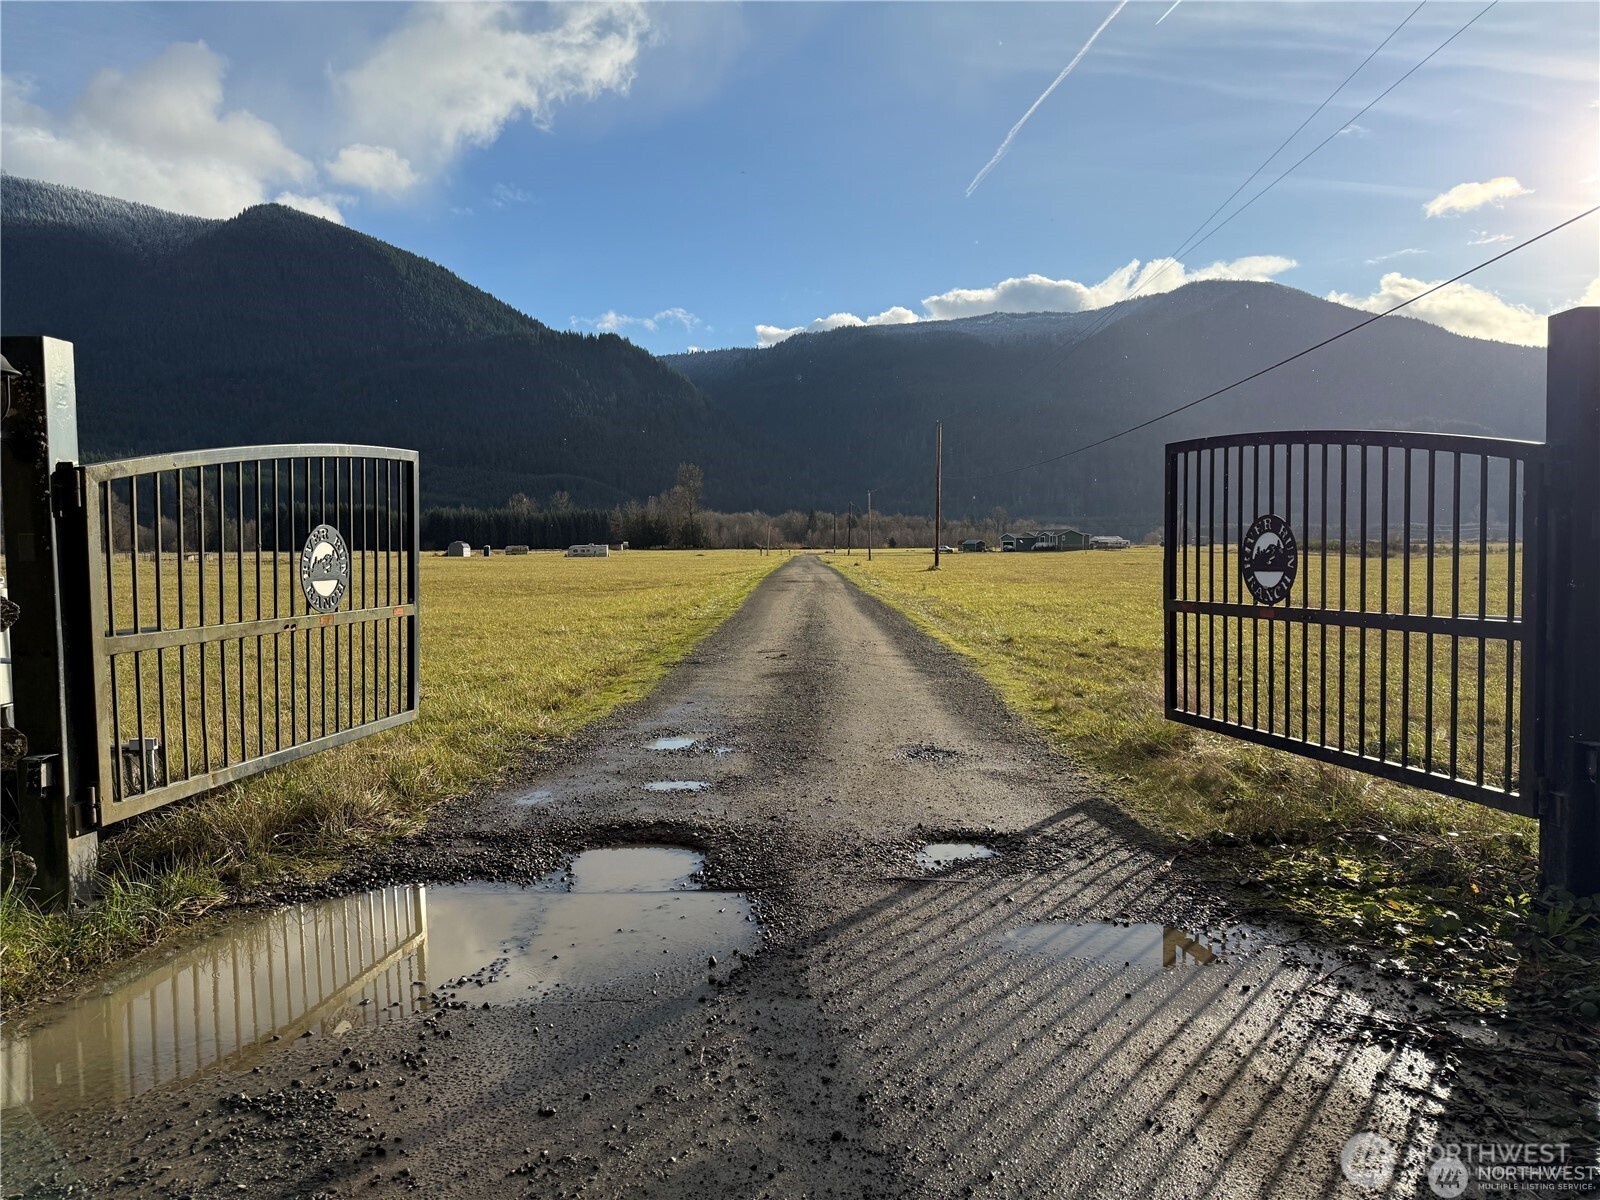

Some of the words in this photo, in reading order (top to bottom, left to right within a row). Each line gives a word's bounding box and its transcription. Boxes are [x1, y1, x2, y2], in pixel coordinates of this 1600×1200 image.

[303, 527, 329, 581] RIVER
[333, 534, 349, 577] RUN
[306, 583, 346, 609] RANCH
